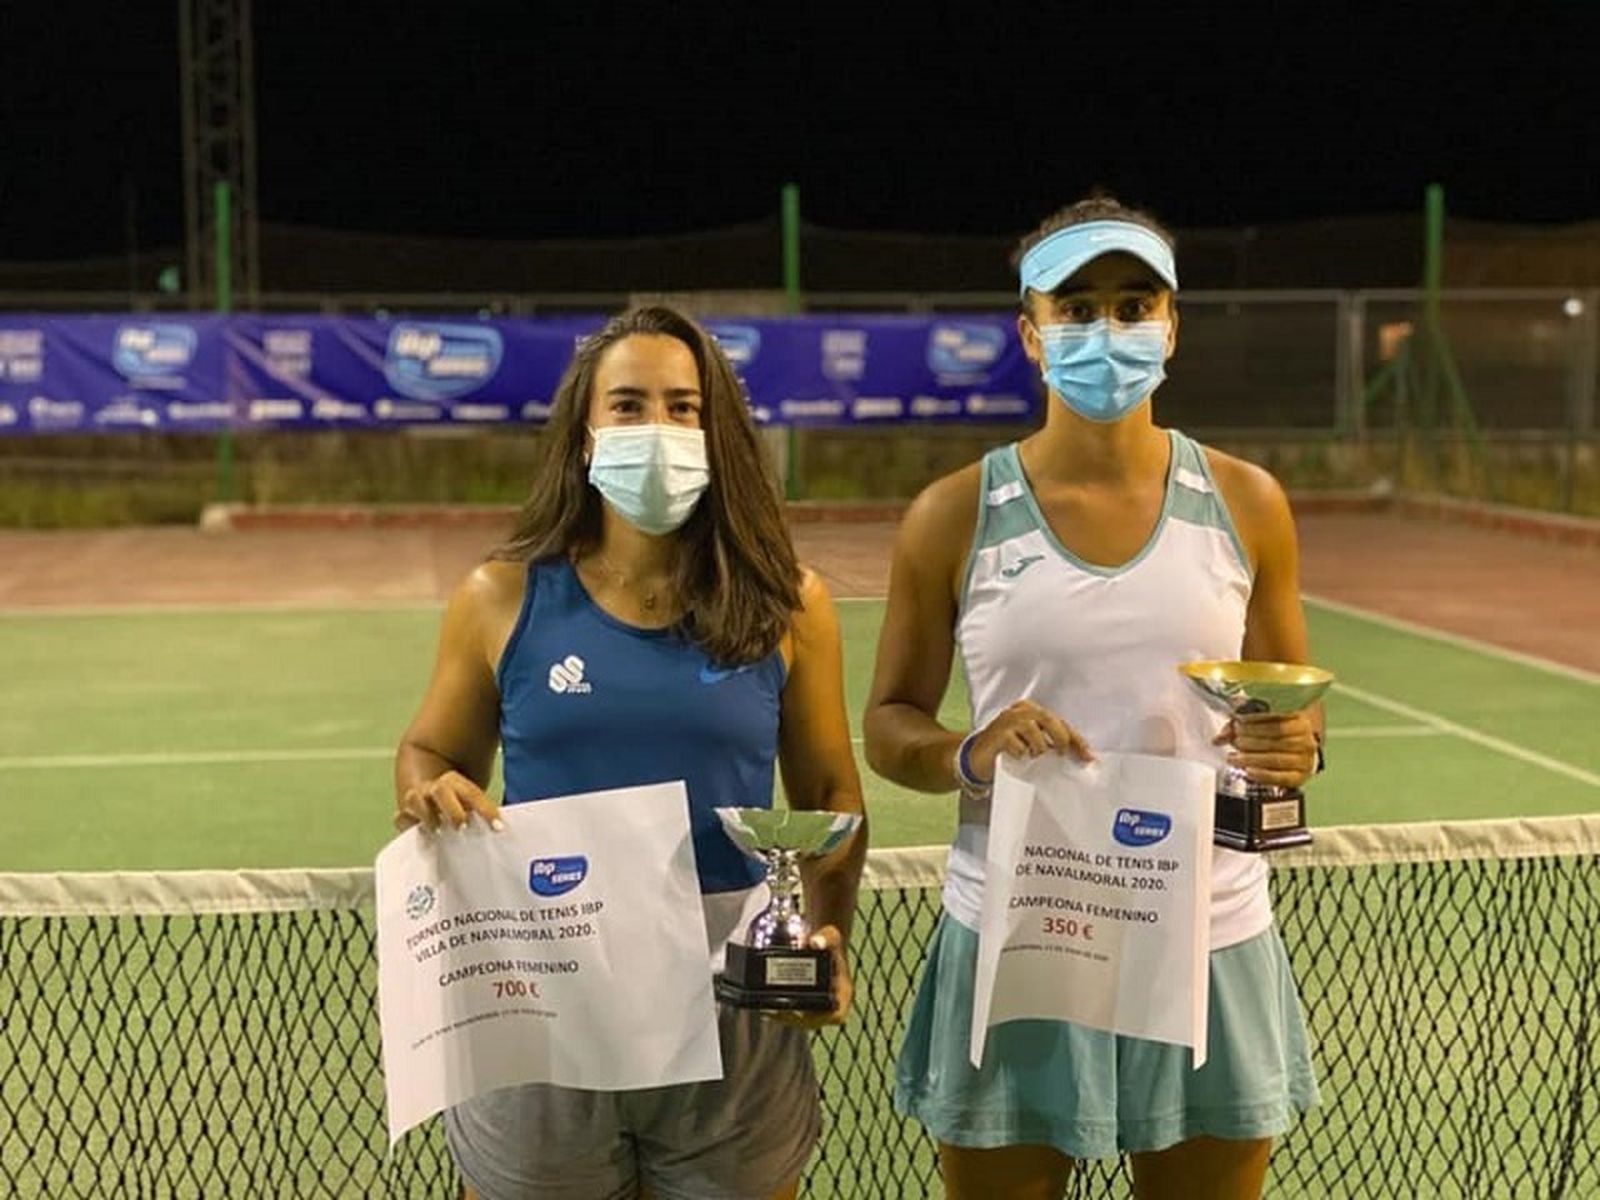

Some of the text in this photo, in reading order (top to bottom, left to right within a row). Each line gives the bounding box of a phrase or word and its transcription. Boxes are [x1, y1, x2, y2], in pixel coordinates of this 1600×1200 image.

[1024, 846, 1179, 872] NACIONAL DE TENIS IBP
[1015, 863, 1168, 891] DE NAVALMORAL 2020.
[1009, 896, 1159, 924] CAMPEONA FEMENINO
[406, 901, 604, 949] TORNEO NACIONAL DE TENIS IBP
[1043, 917, 1094, 940] 350 €
[416, 924, 596, 963] VILLA DE NAVALMORAL 2020.
[438, 959, 579, 987] CAMPEONA FEMENINO
[493, 980, 540, 999] 700 €
